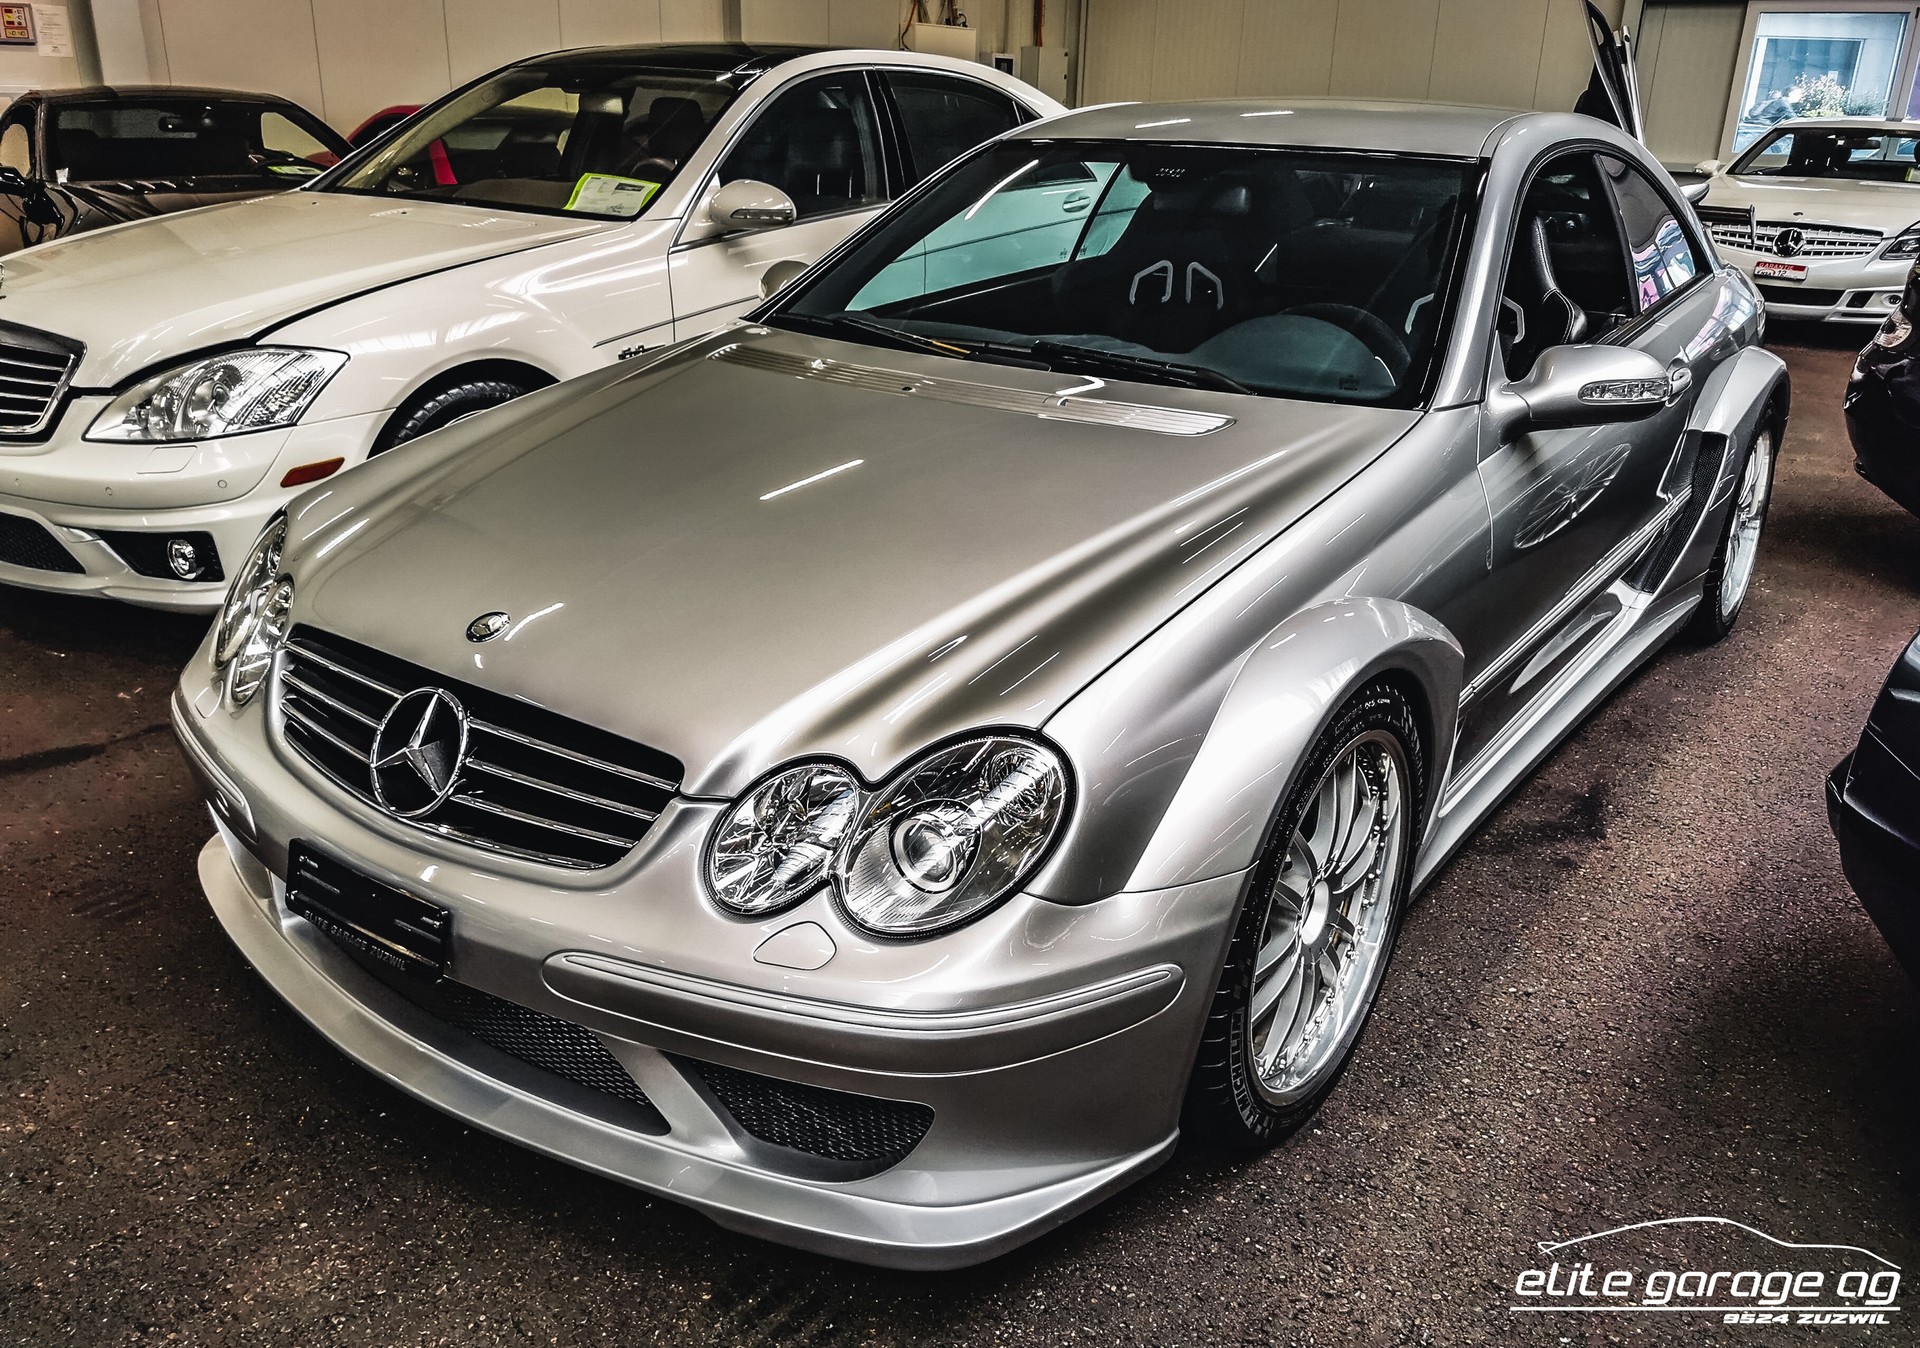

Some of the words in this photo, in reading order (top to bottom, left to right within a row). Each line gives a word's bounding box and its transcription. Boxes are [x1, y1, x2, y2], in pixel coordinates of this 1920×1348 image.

[1759, 262, 1794, 271] GARANTIE
[304, 910, 328, 930] ELITE
[331, 925, 367, 950] GARAGE
[371, 946, 406, 970] ZUZWIL
[1230, 1009, 1253, 1113] MICHELIN
